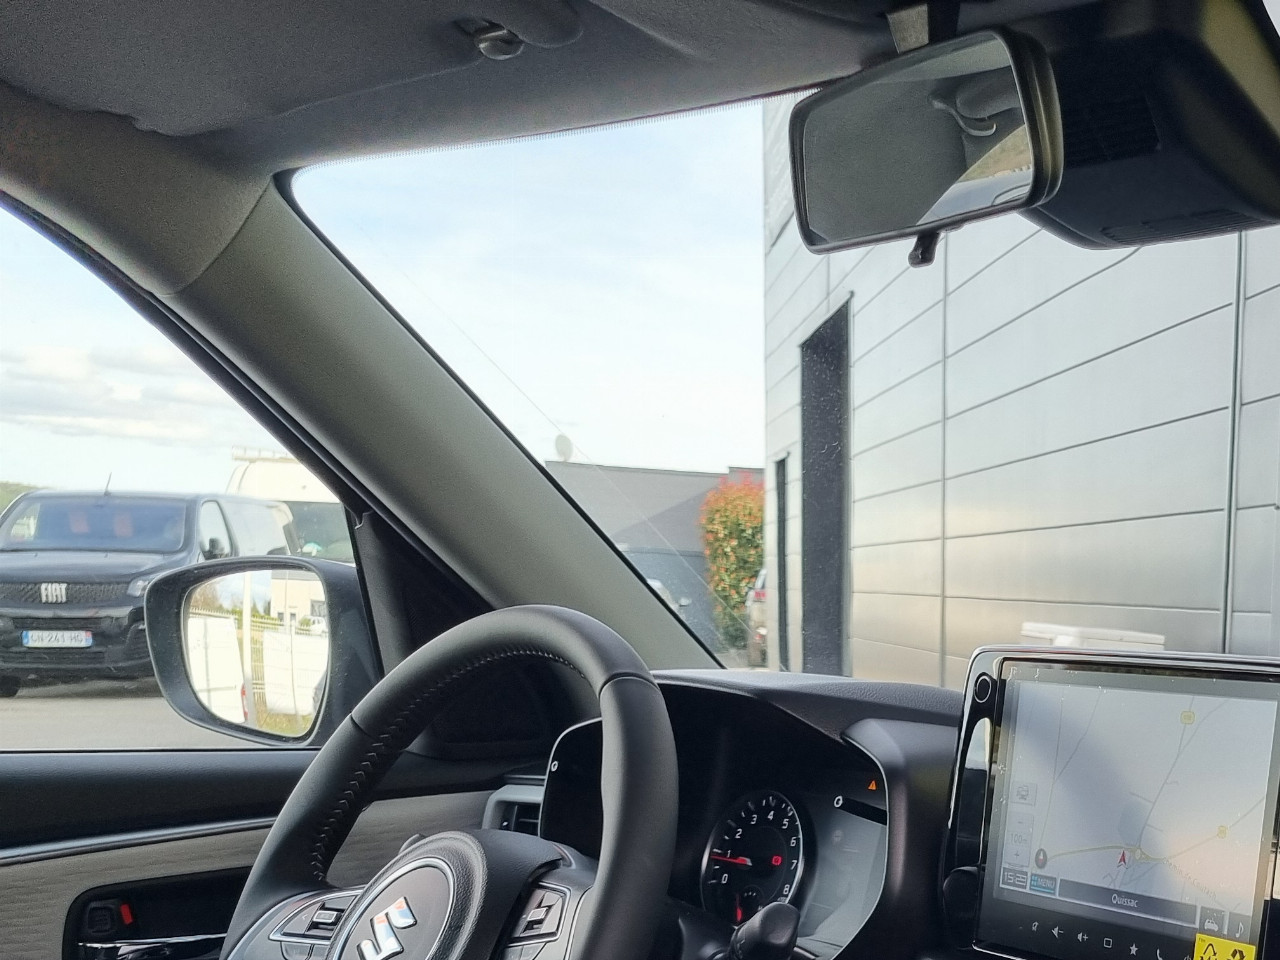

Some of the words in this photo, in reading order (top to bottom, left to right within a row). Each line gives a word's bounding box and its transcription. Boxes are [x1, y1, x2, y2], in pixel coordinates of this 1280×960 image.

[41, 582, 67, 604] FIAT
[750, 814, 758, 825] 3
[767, 810, 775, 821] 4
[782, 818, 789, 829] 5
[735, 828, 743, 839] 2
[790, 836, 797, 847] 6
[727, 850, 732, 858] 1
[790, 860, 798, 870] 7
[721, 873, 729, 884] 0
[1037, 878, 1055, 889] MENU
[783, 884, 790, 895] 8
[1111, 893, 1139, 908] Quissac
